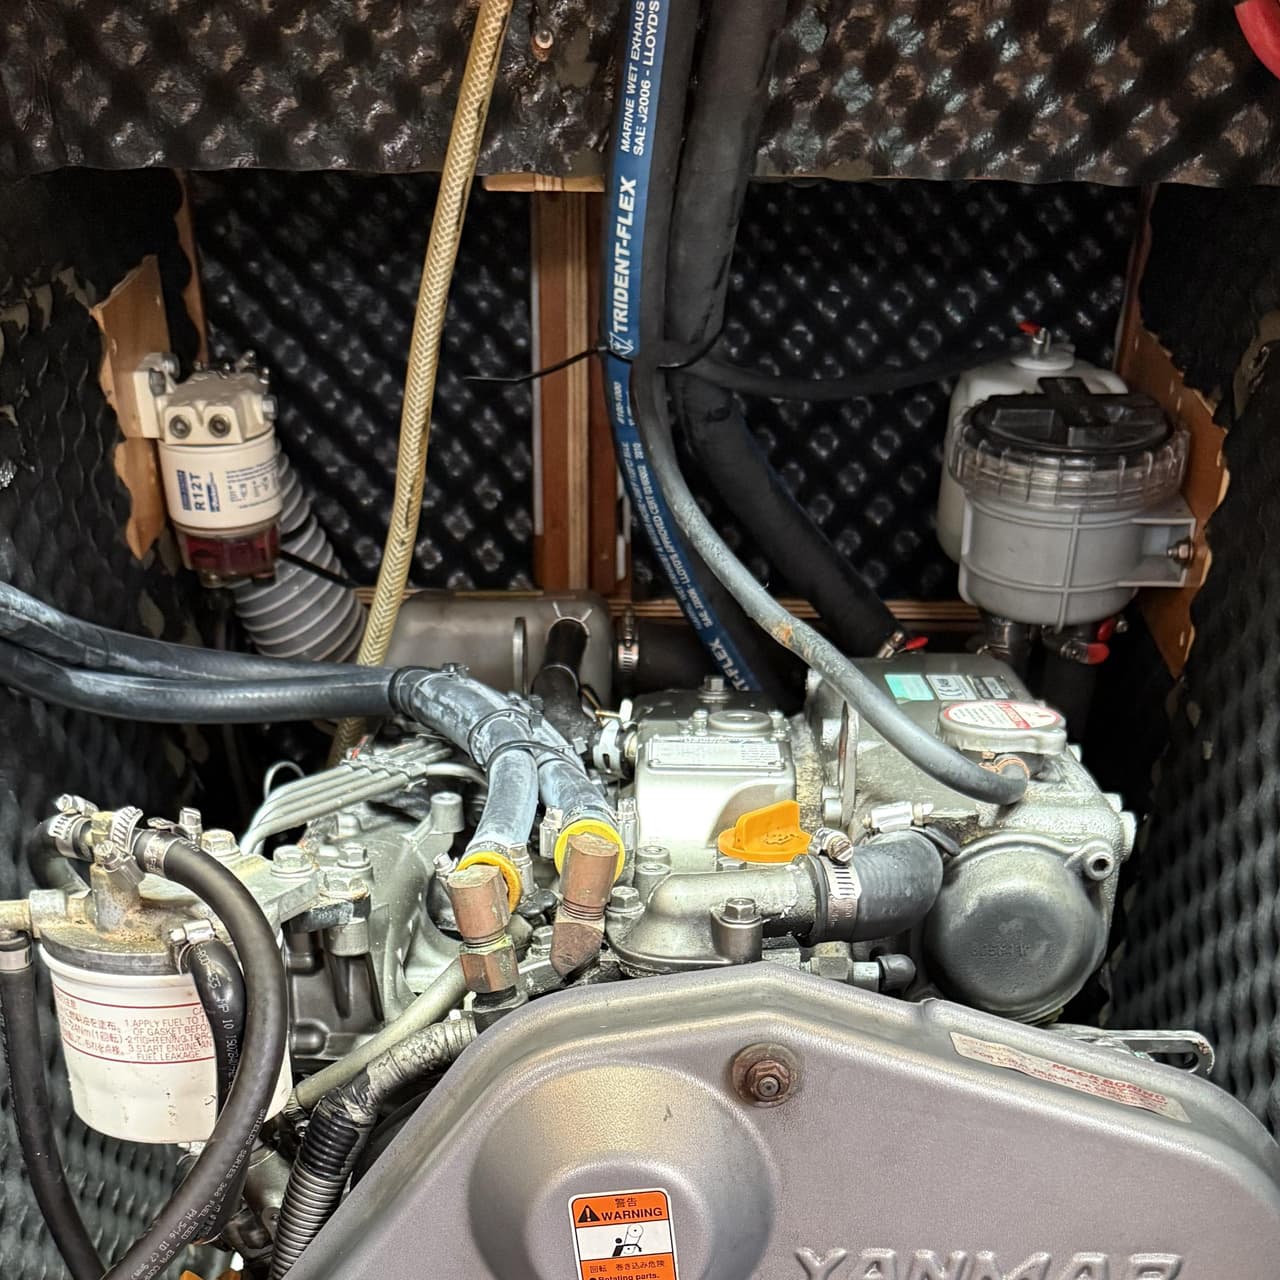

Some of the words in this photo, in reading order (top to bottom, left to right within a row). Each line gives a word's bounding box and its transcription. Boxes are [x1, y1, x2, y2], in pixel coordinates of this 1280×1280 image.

[644, 0, 660, 66] LLOYD'S
[625, 63, 639, 97] WET
[639, 78, 651, 124] J2006
[620, 103, 633, 153] MARINE
[633, 126, 648, 156] SAE
[613, 176, 637, 333] TRIDENT-FLEX
[189, 472, 206, 511] R12T
[147, 1027, 183, 1036] GASKET
[162, 1018, 185, 1026] FUEL
[187, 1016, 199, 1024] TO
[221, 1017, 235, 1031] 10
[136, 1044, 162, 1053] START
[166, 1042, 198, 1052] ENGINE
[161, 1050, 200, 1060] LEAKAGE
[245, 1108, 265, 1146] SHIELDS
[226, 1149, 247, 1178] SERIES
[198, 1198, 215, 1218] FUEL
[601, 1207, 663, 1222] WARNING
[182, 1221, 199, 1240] FEED
[157, 1239, 169, 1252] ID
